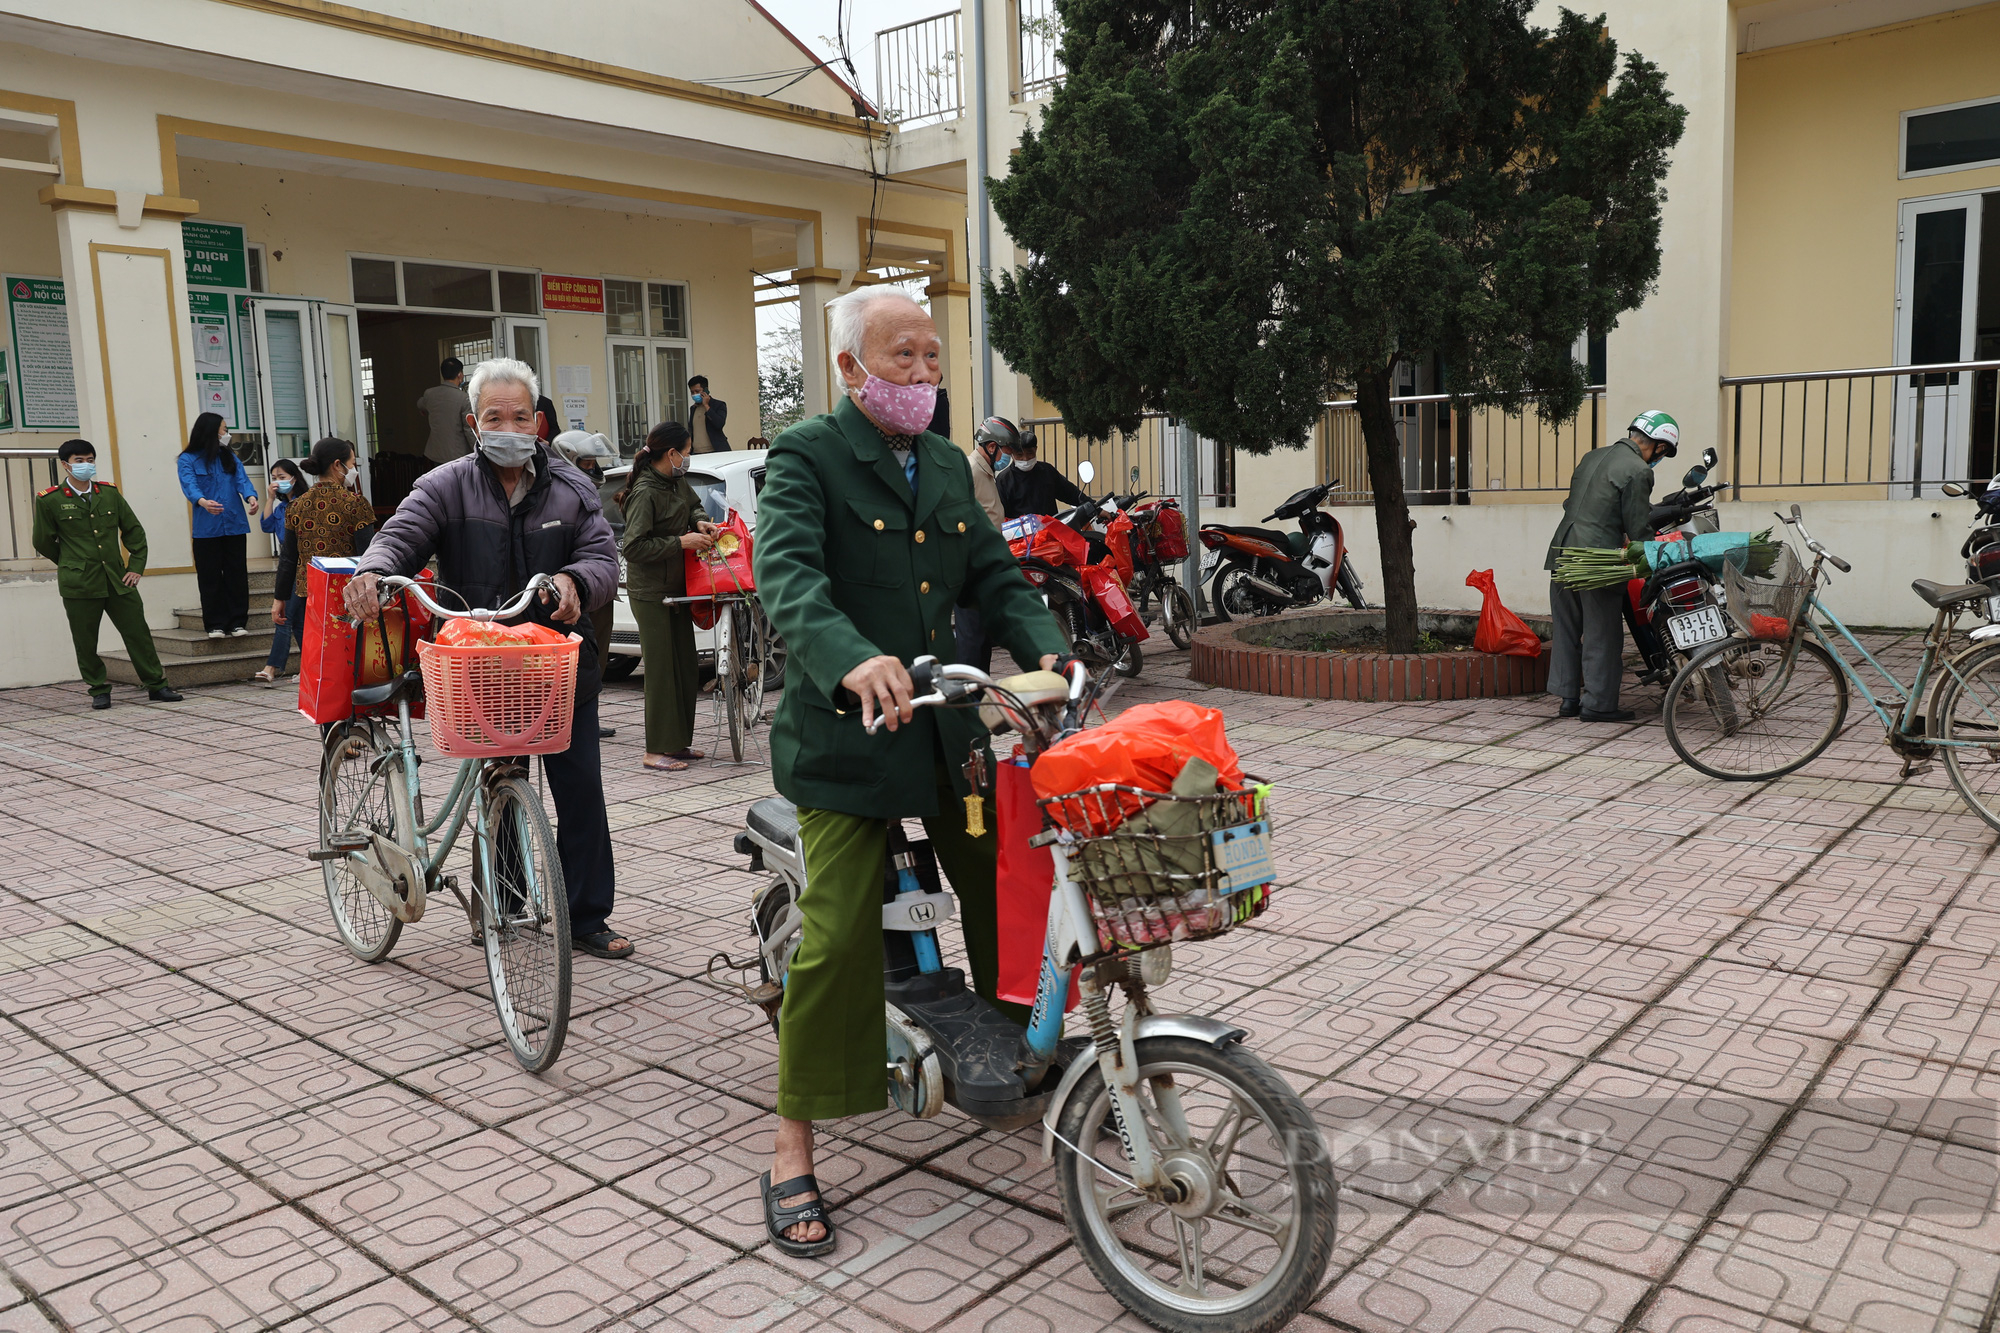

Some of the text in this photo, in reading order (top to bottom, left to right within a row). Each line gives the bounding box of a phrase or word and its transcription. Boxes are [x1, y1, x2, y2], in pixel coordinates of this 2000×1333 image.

[196, 250, 228, 262] DỊCH
[193, 263, 212, 273] AN
[547, 278, 598, 294] ĐIỂM TIẾP CÔNG DÂN
[34, 290, 49, 301] NỘI
[1677, 610, 1712, 631] 33-L4
[1683, 625, 1717, 644] 4276
[1224, 838, 1266, 864] HONDA
[1252, 866, 1271, 876] JAPAN
[1031, 954, 1048, 1032] HONDA
[1108, 1083, 1136, 1161] HONDA
